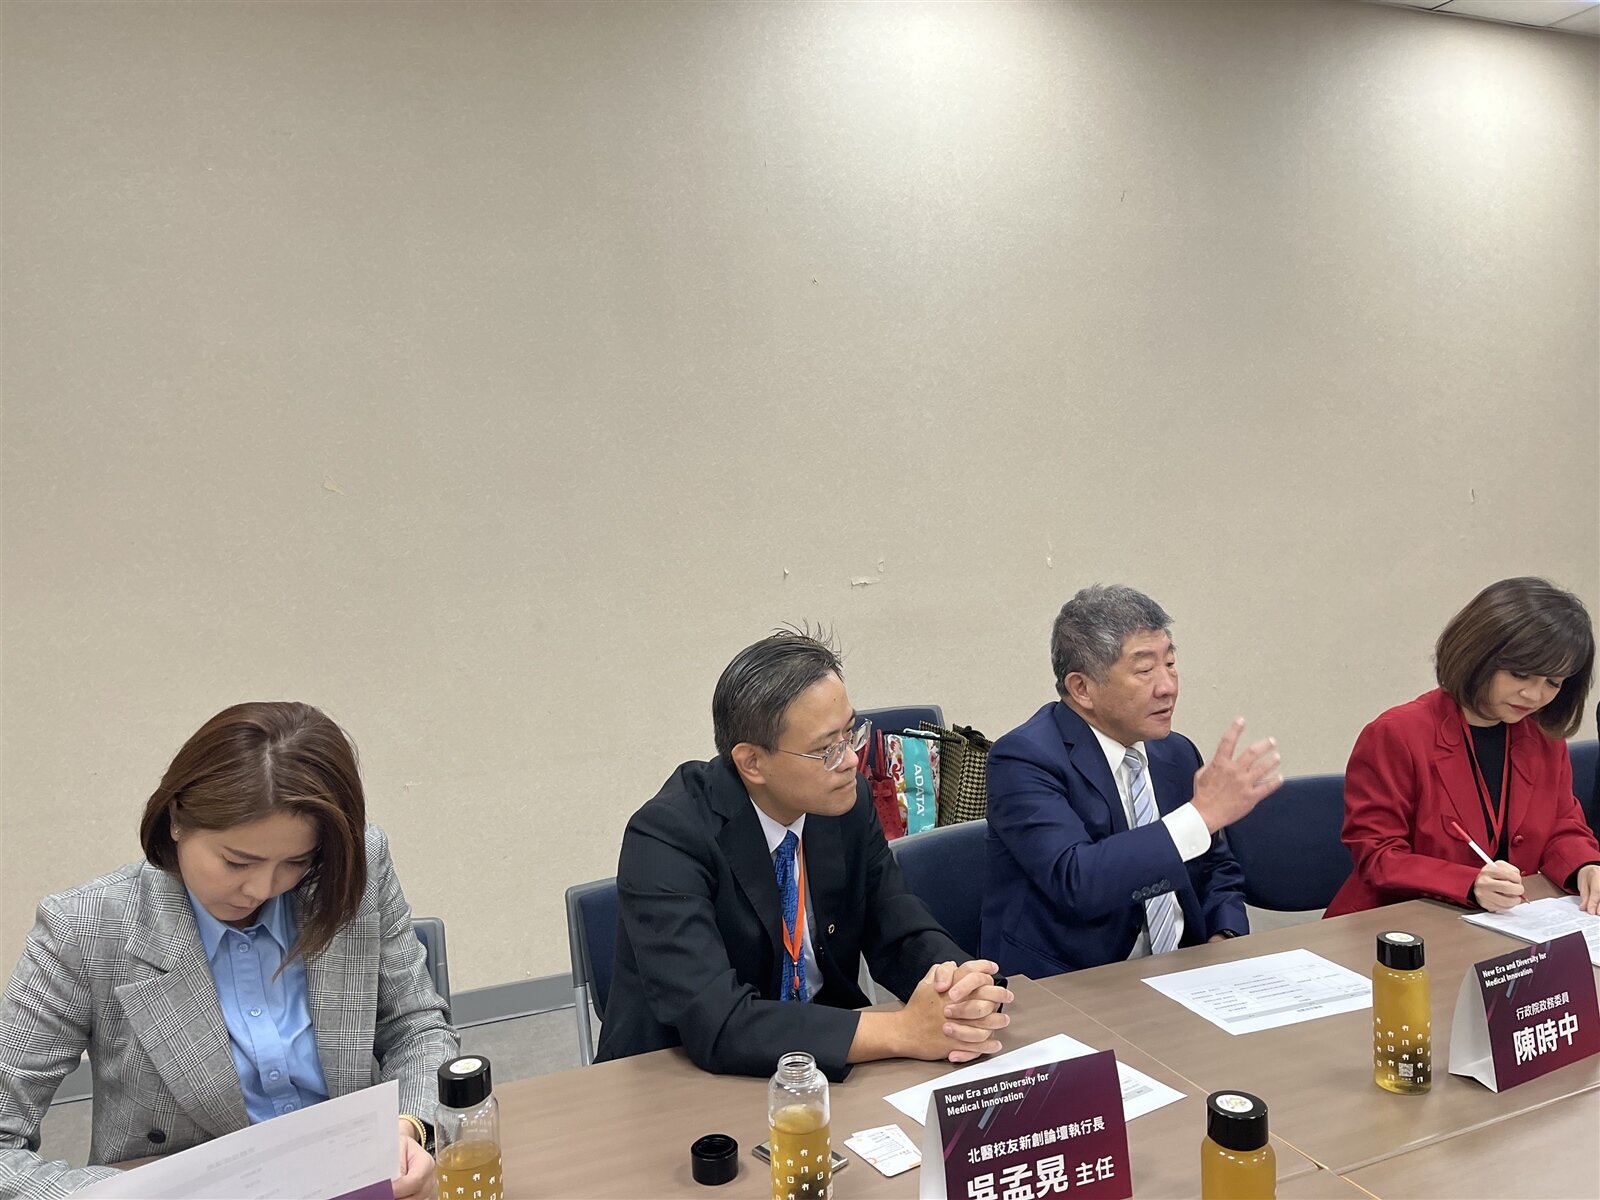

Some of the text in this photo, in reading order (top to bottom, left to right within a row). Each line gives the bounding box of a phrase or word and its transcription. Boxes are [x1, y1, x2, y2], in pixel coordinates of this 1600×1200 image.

[913, 764, 925, 816] ADATA
[1482, 952, 1547, 978] New Era and Diversity for
[1485, 968, 1533, 988] Medical Innovation
[1516, 992, 1570, 1020] 行政院政務委員
[1513, 1012, 1579, 1066] 陳時中
[945, 1073, 1049, 1104] New Era and Diversity for
[947, 1092, 1024, 1117] Medical Innovation
[967, 1116, 1105, 1164] 北醫校友新創論壇執行長
[1076, 1155, 1115, 1187] 主任
